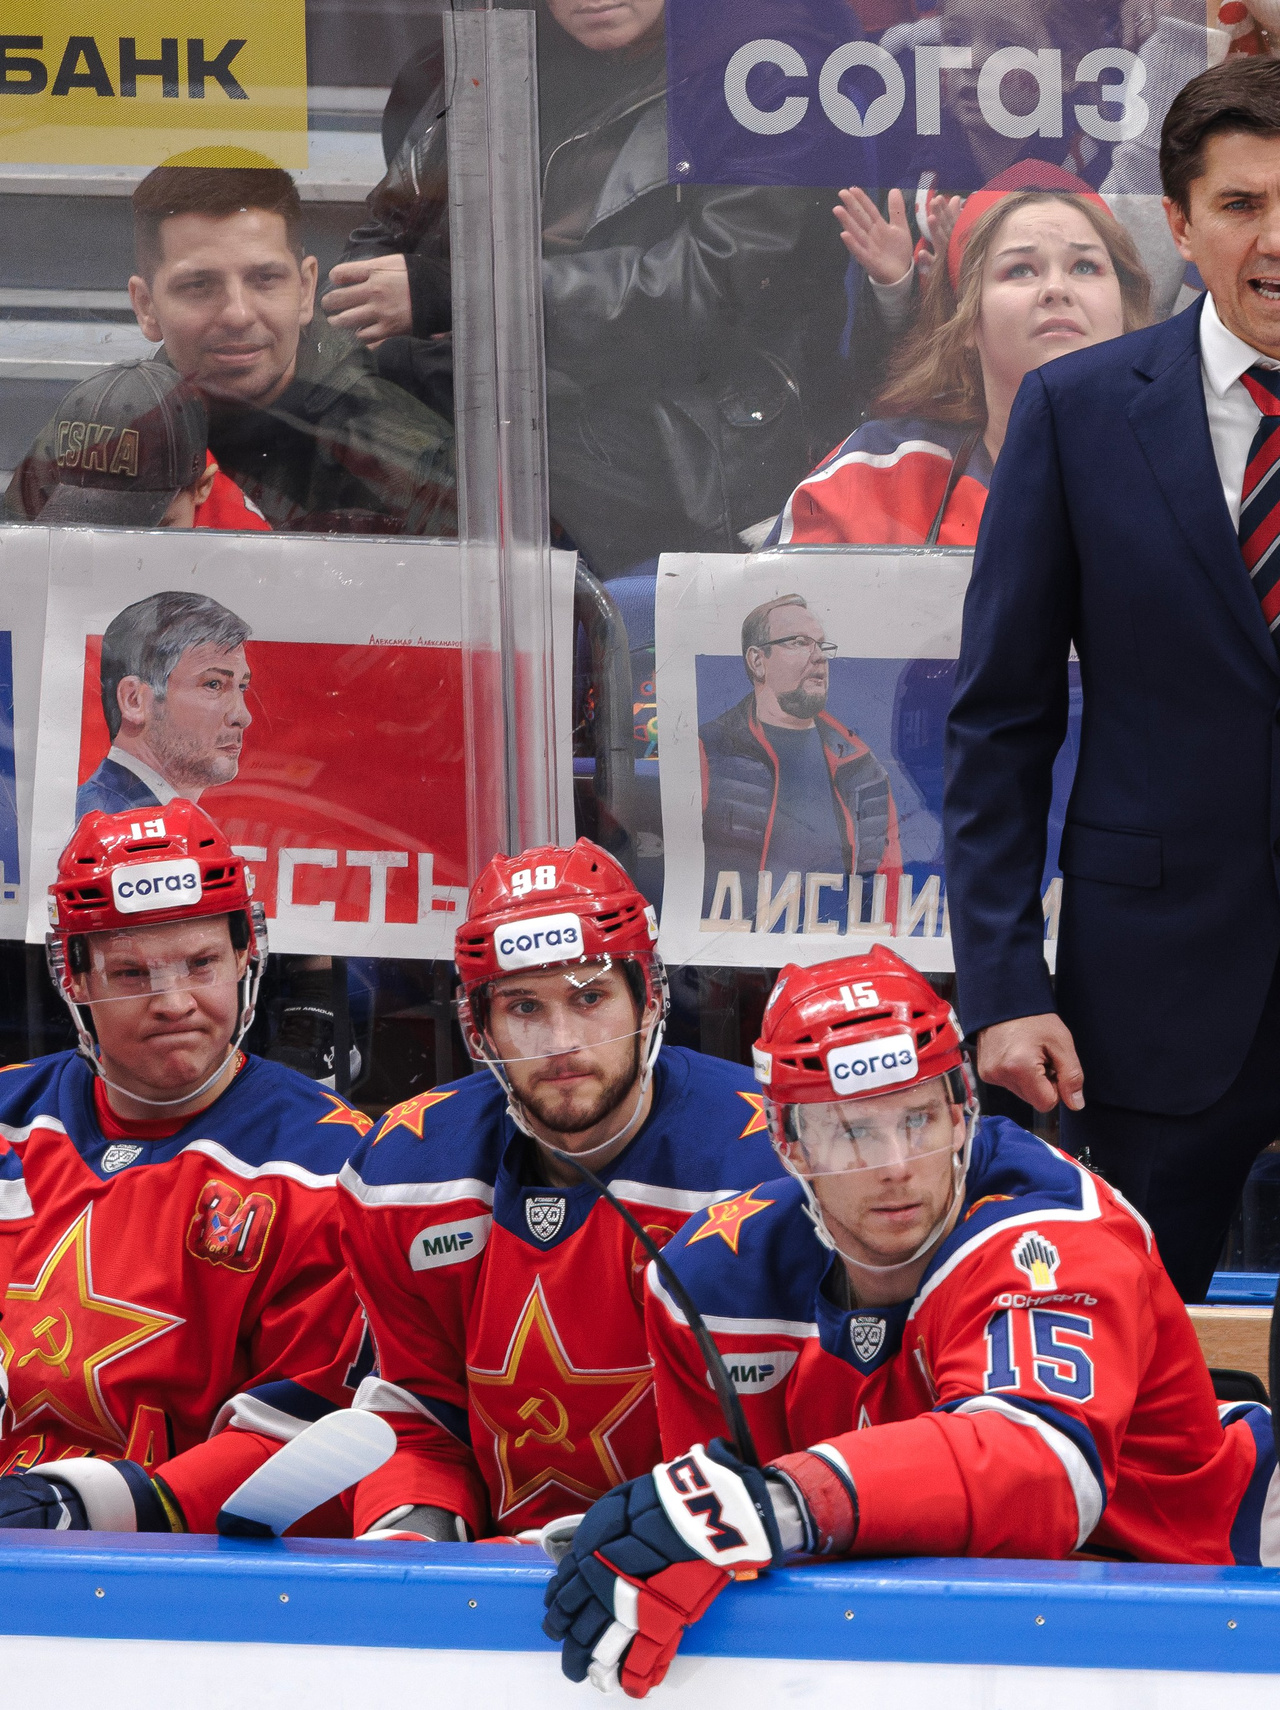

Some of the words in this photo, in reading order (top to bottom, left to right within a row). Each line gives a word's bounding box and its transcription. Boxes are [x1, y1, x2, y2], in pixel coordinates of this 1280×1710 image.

[0, 35, 249, 100] БАНК
[130, 818, 167, 840] 19
[511, 865, 557, 897] 98
[839, 981, 880, 1012] 15
[422, 1231, 474, 1257] МИР
[982, 1307, 1094, 1404] 15
